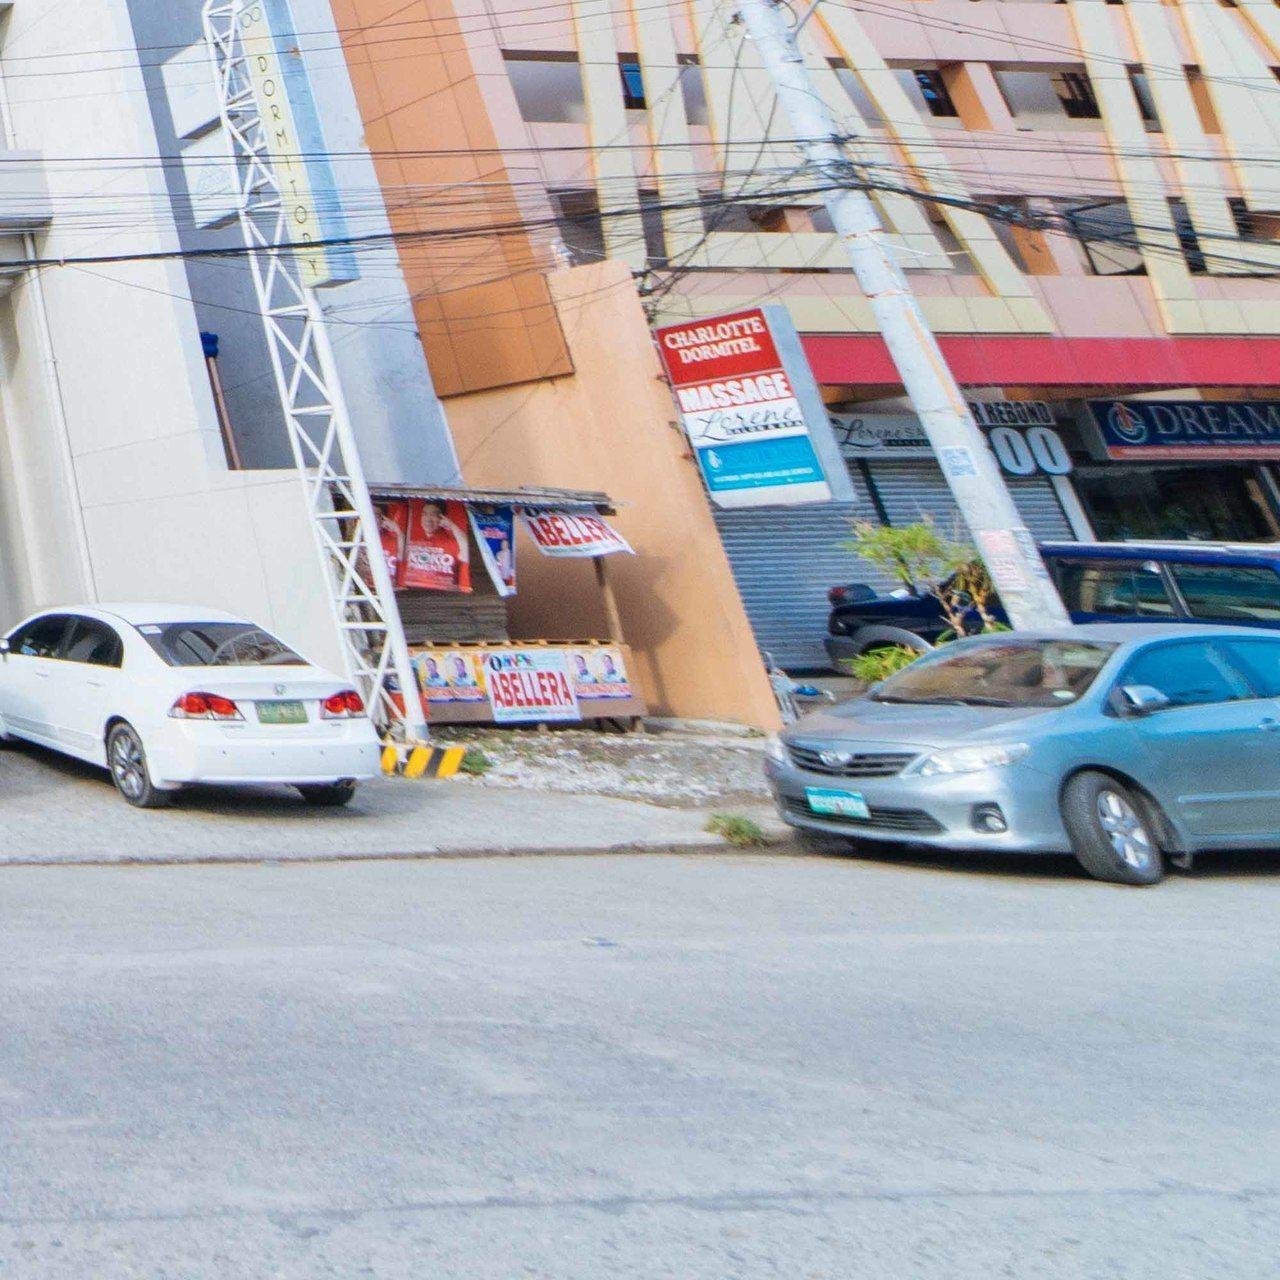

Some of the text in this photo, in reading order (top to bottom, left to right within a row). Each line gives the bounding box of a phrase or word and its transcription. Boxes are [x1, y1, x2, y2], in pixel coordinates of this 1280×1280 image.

[256, 56, 318, 277] DORMITORY
[664, 316, 766, 349] CHARLOTTE
[678, 336, 762, 364] DORMITEL
[676, 373, 793, 413] MASSAGE
[490, 672, 574, 707] ABELLERA
